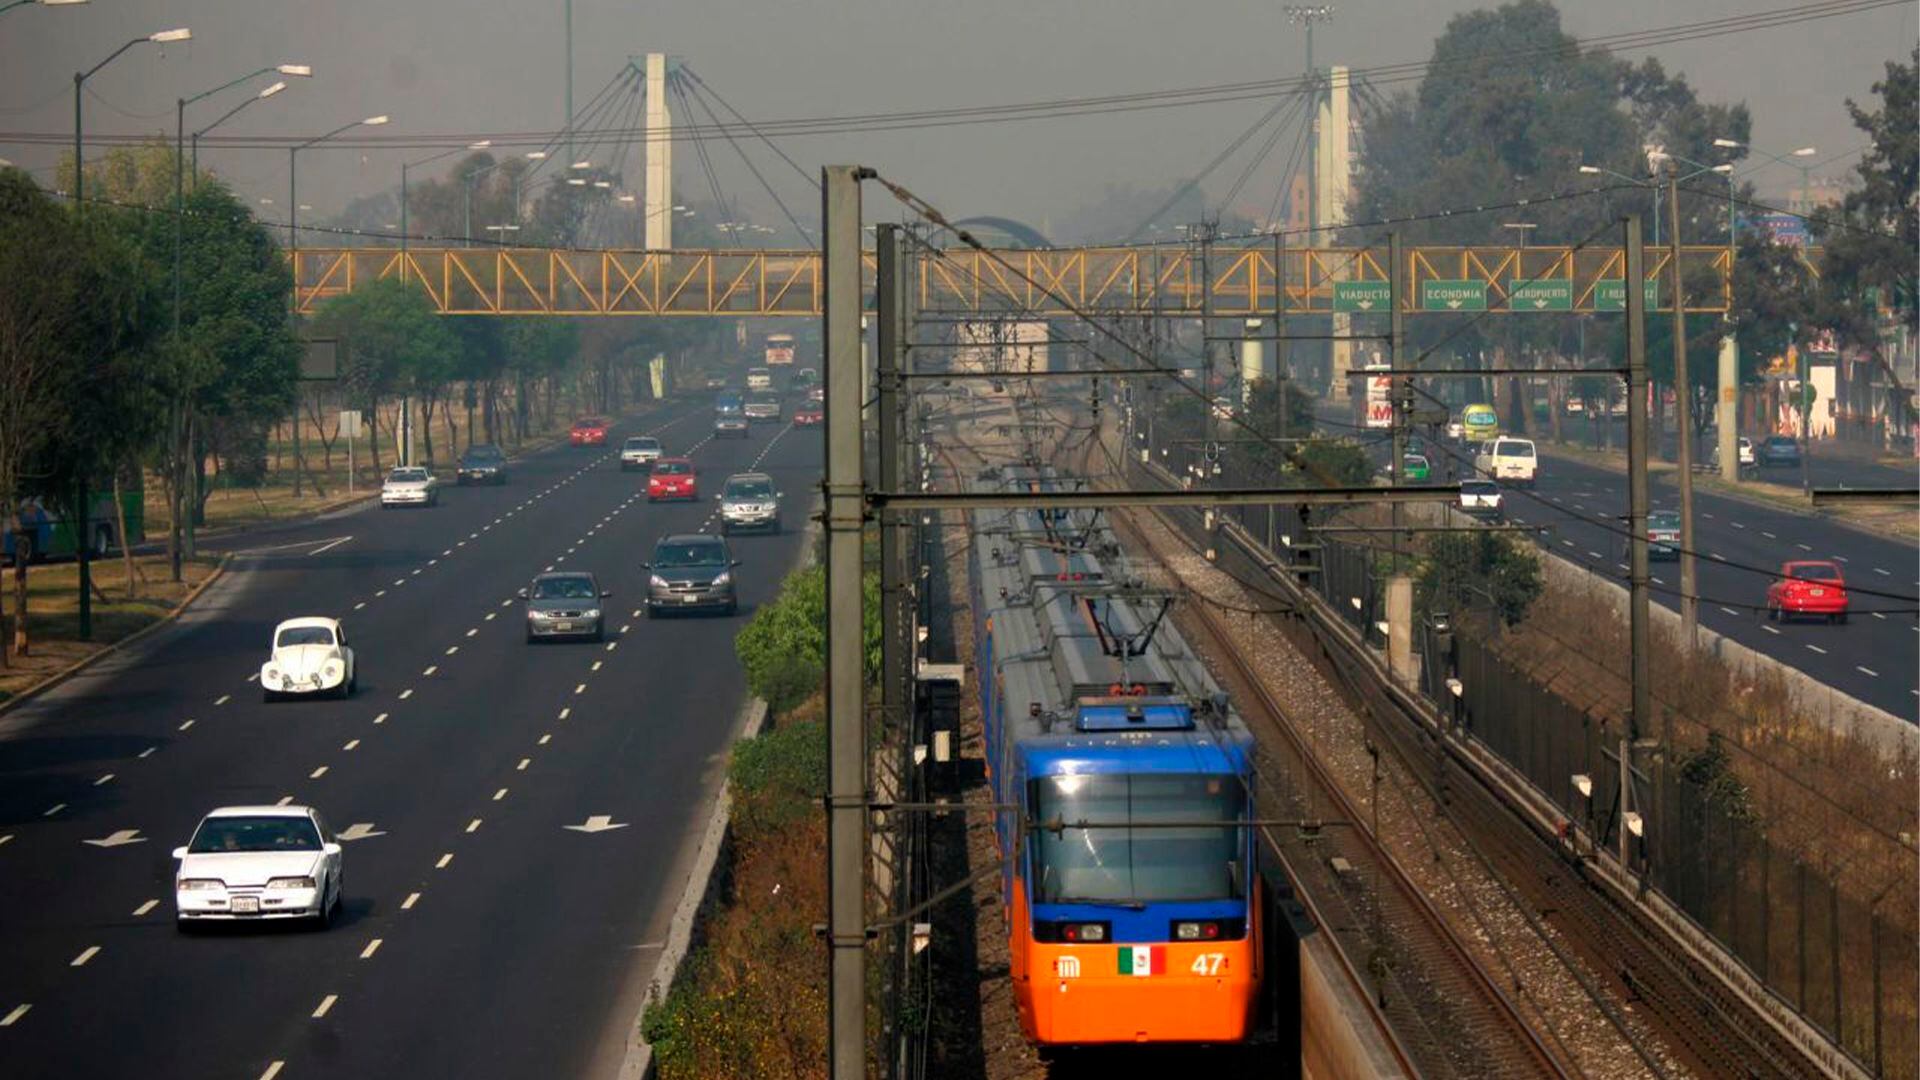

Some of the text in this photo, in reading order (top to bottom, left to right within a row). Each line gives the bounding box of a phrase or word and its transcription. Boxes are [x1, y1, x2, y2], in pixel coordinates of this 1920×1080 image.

[1339, 289, 1391, 299] VIADUCTO
[1426, 289, 1481, 299] ECONOMIA
[1190, 952, 1225, 977] 47
